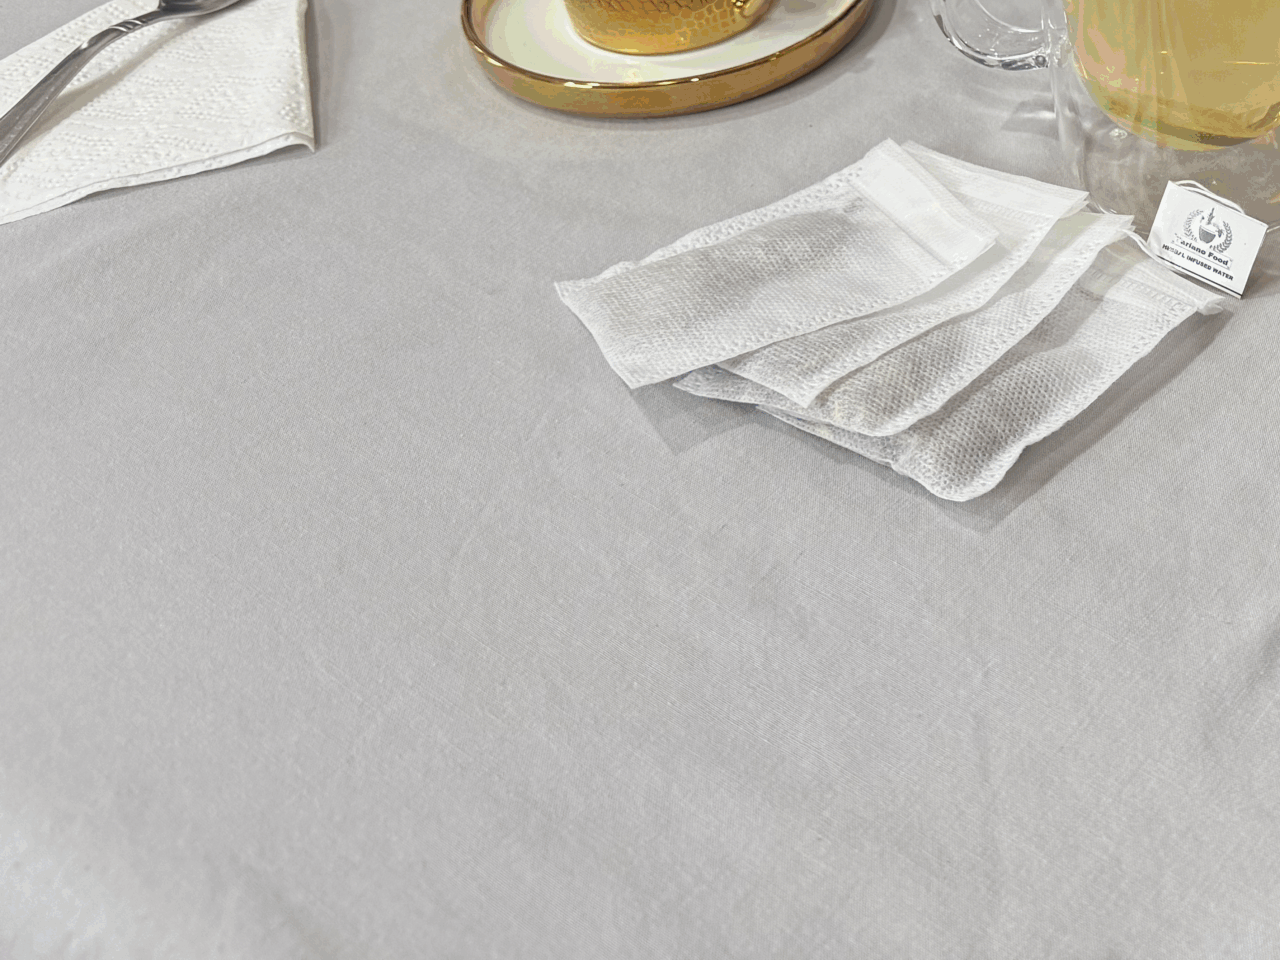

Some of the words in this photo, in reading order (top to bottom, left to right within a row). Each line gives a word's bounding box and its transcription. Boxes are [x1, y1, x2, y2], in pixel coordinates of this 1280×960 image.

[1186, 255, 1212, 270] INFUSED
[1212, 266, 1234, 281] WATER
[1208, 251, 1228, 266] Food
